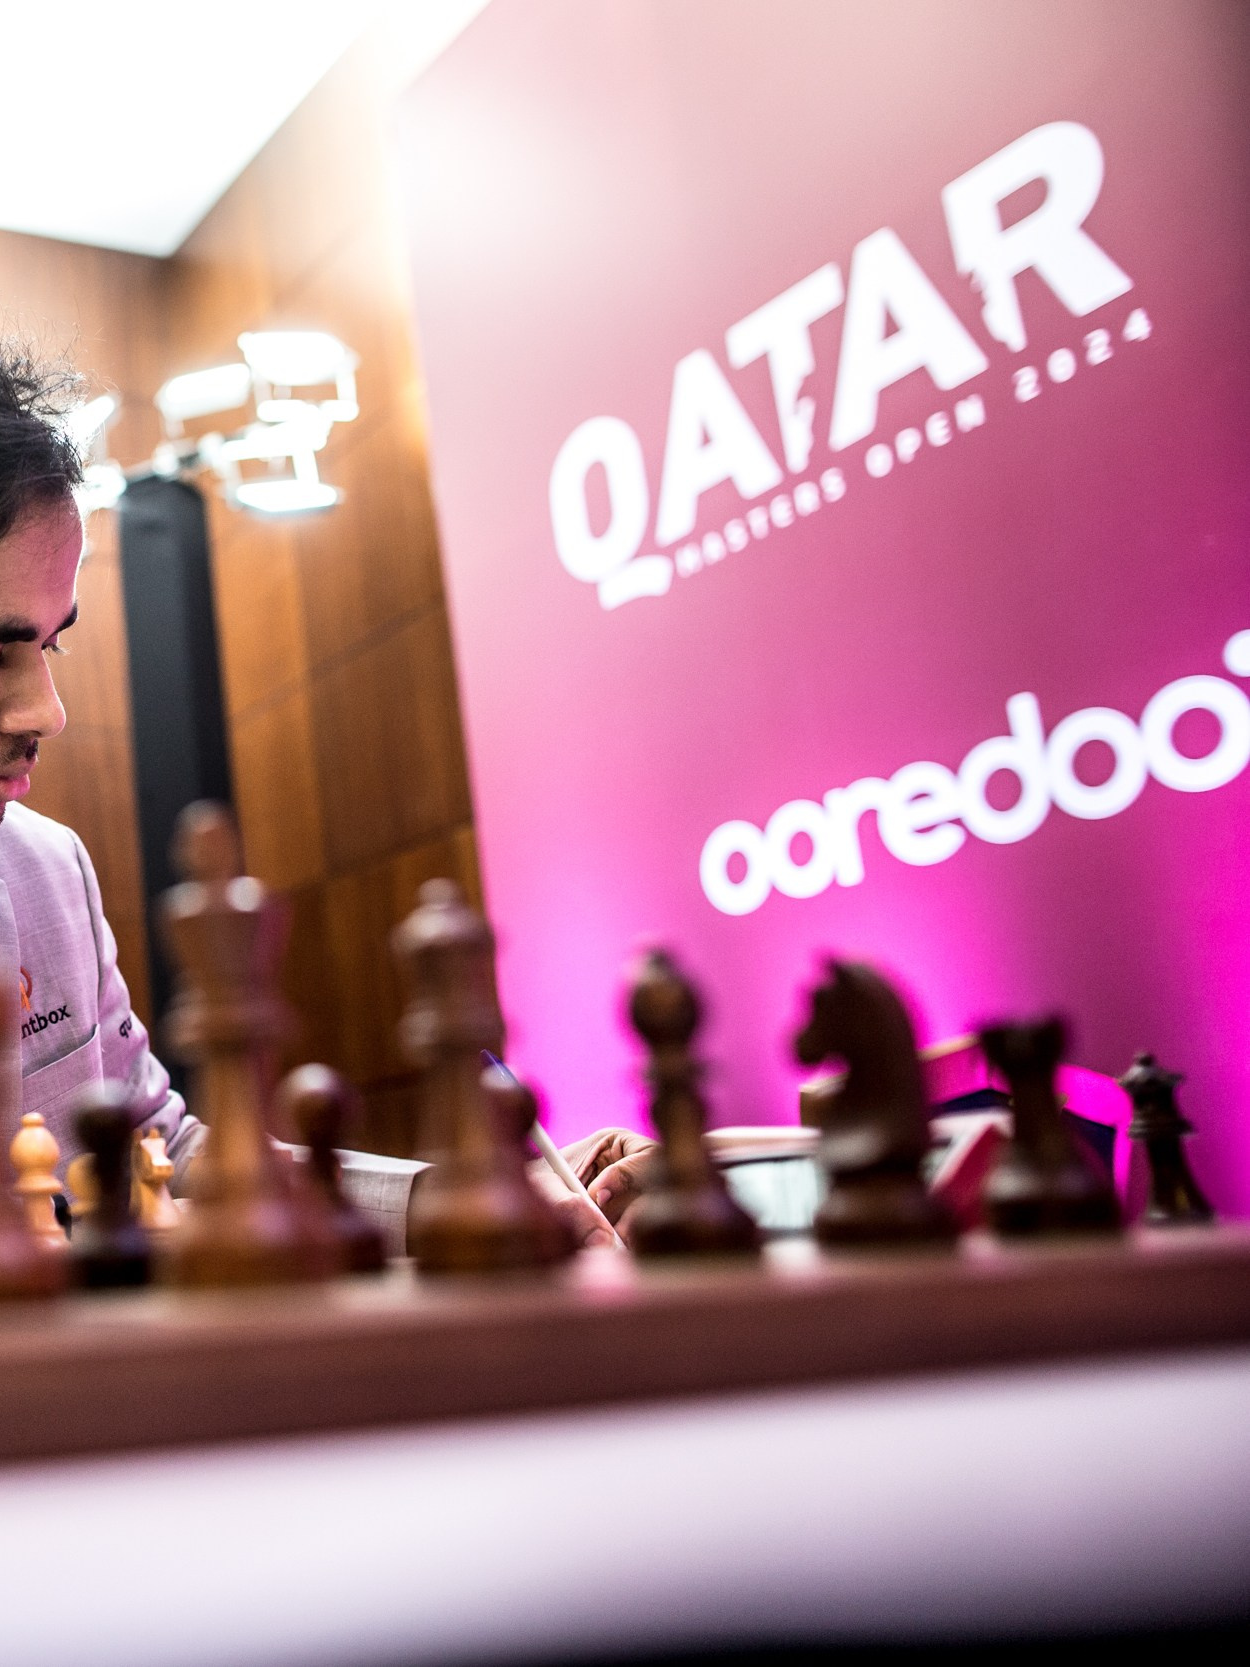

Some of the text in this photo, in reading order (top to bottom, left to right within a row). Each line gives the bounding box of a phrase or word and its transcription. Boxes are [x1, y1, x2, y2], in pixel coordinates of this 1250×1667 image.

[549, 120, 1134, 611] QATAR
[674, 308, 1152, 578] MASTERS OPEN 2024
[699, 675, 1250, 916] ooredoo
[21, 1005, 71, 1039] ntbox
